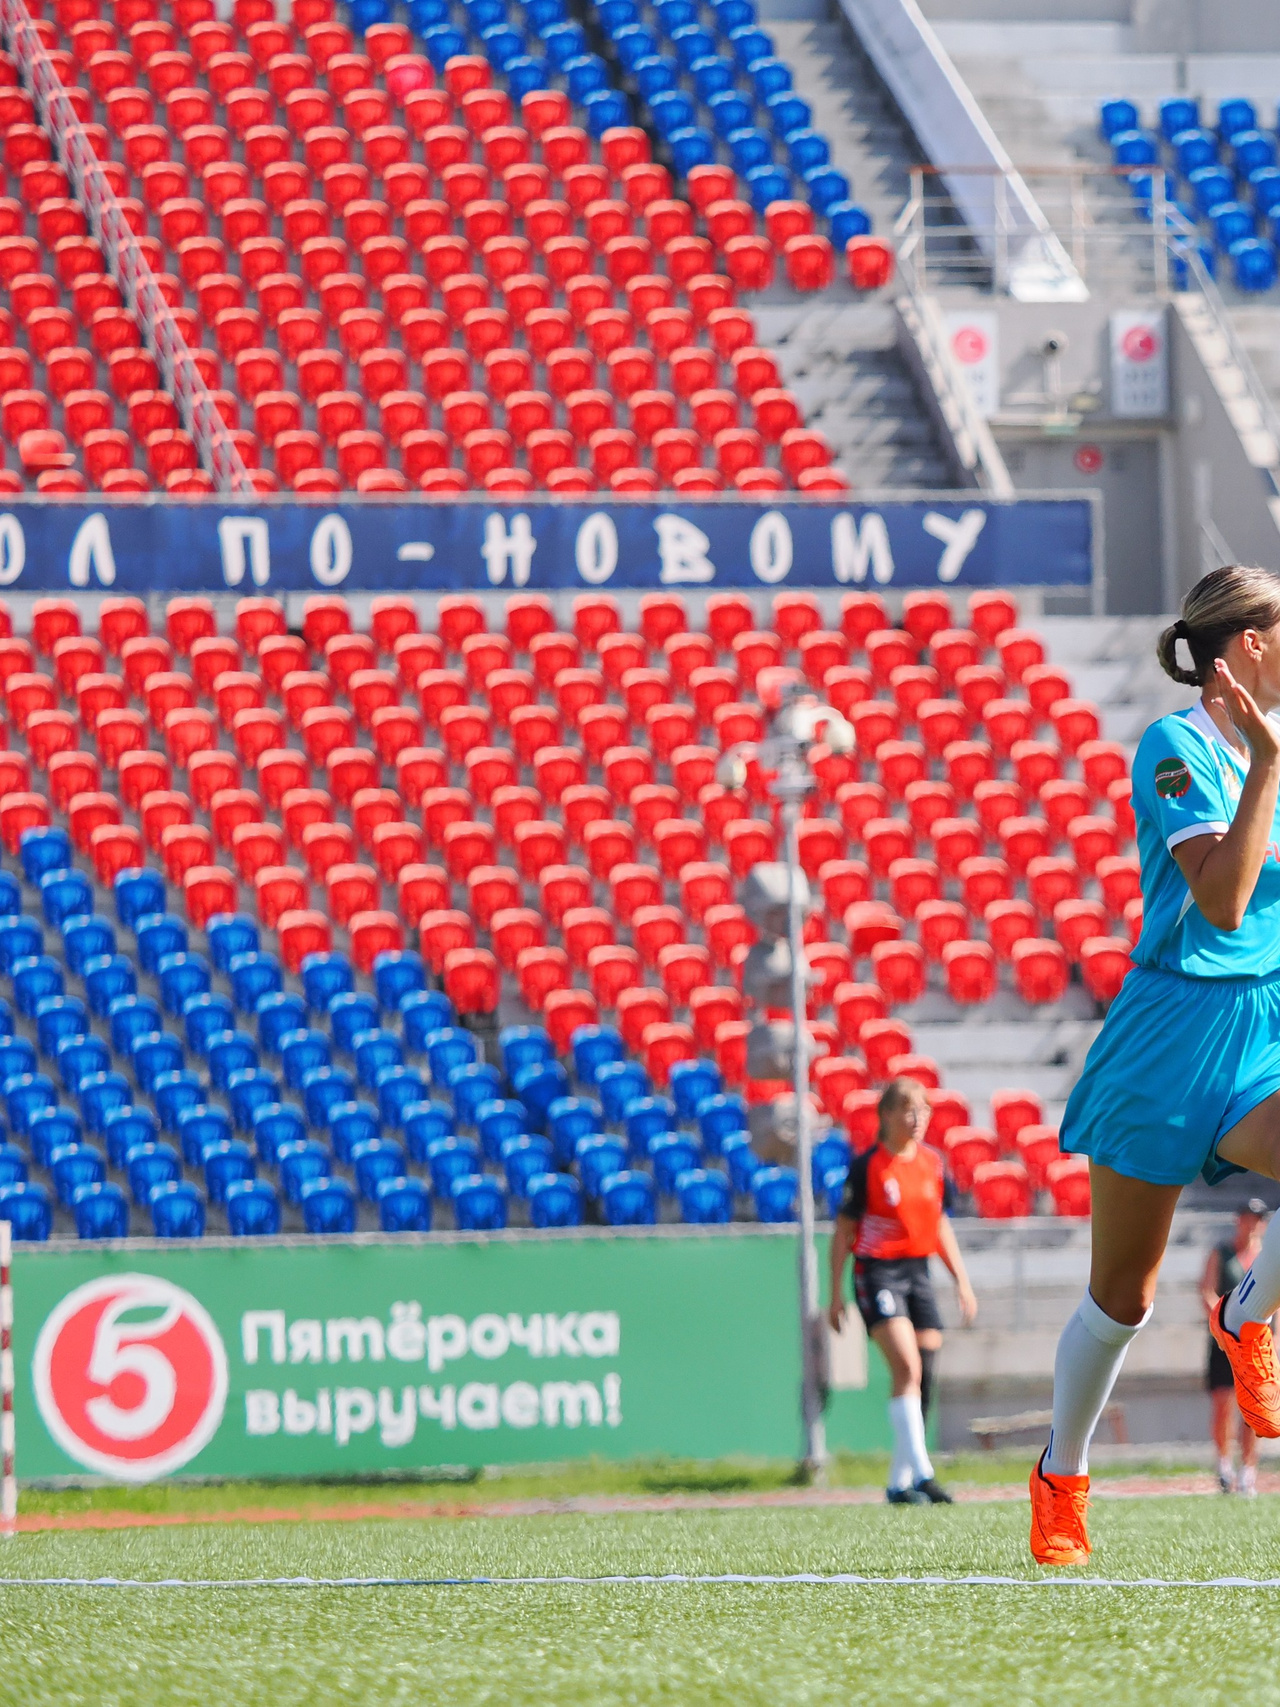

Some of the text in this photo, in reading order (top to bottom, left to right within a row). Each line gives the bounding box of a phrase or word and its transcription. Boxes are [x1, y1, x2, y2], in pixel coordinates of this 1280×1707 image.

[87, 1299, 183, 1440] 5
[241, 1301, 620, 1371] Пятёрочка
[244, 1373, 623, 1446] выручает!
